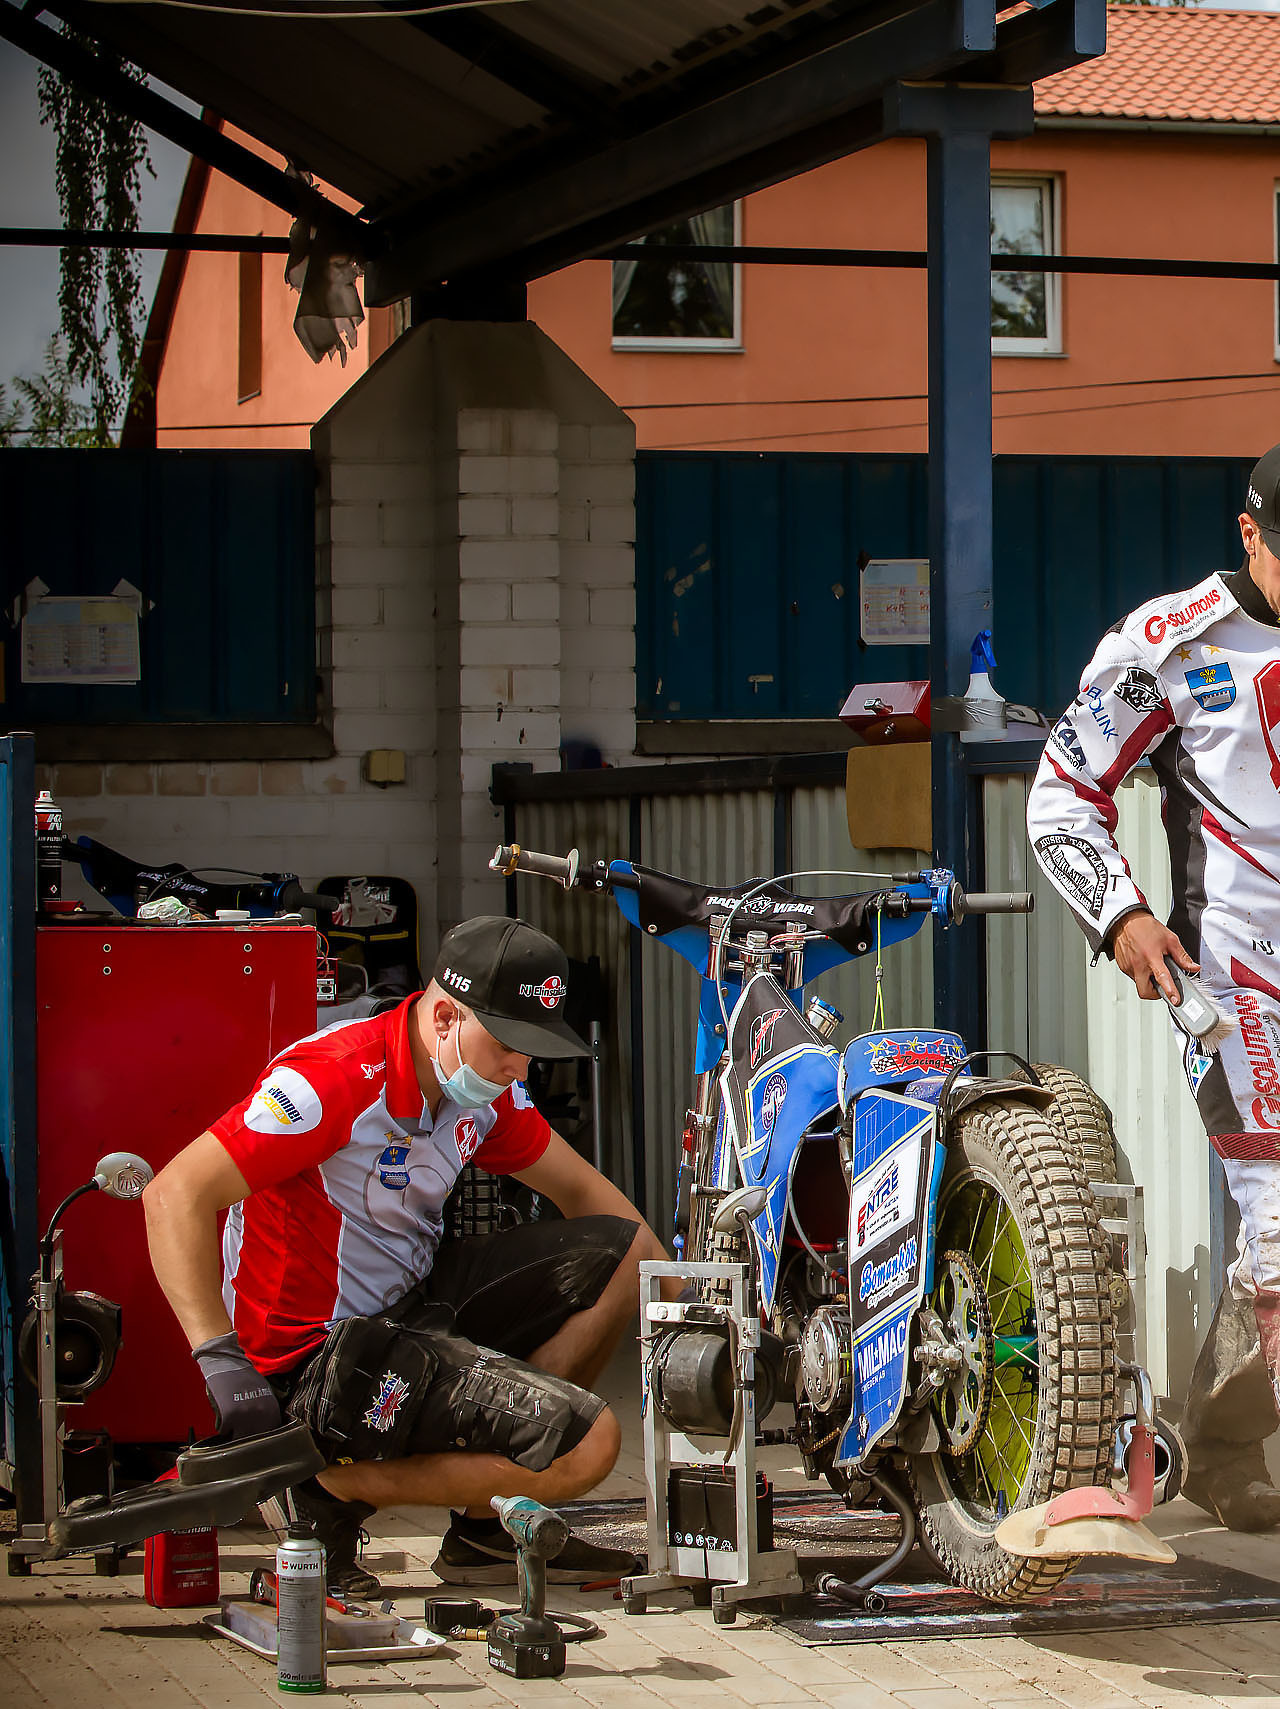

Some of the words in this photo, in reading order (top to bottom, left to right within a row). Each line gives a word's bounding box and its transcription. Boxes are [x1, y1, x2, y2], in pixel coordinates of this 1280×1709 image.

[1145, 589, 1221, 644] G-SOLUTIONS
[773, 903, 815, 916] WEAR
[443, 967, 472, 993] #115
[520, 983, 533, 998] NJ
[901, 1055, 941, 1069] Racing
